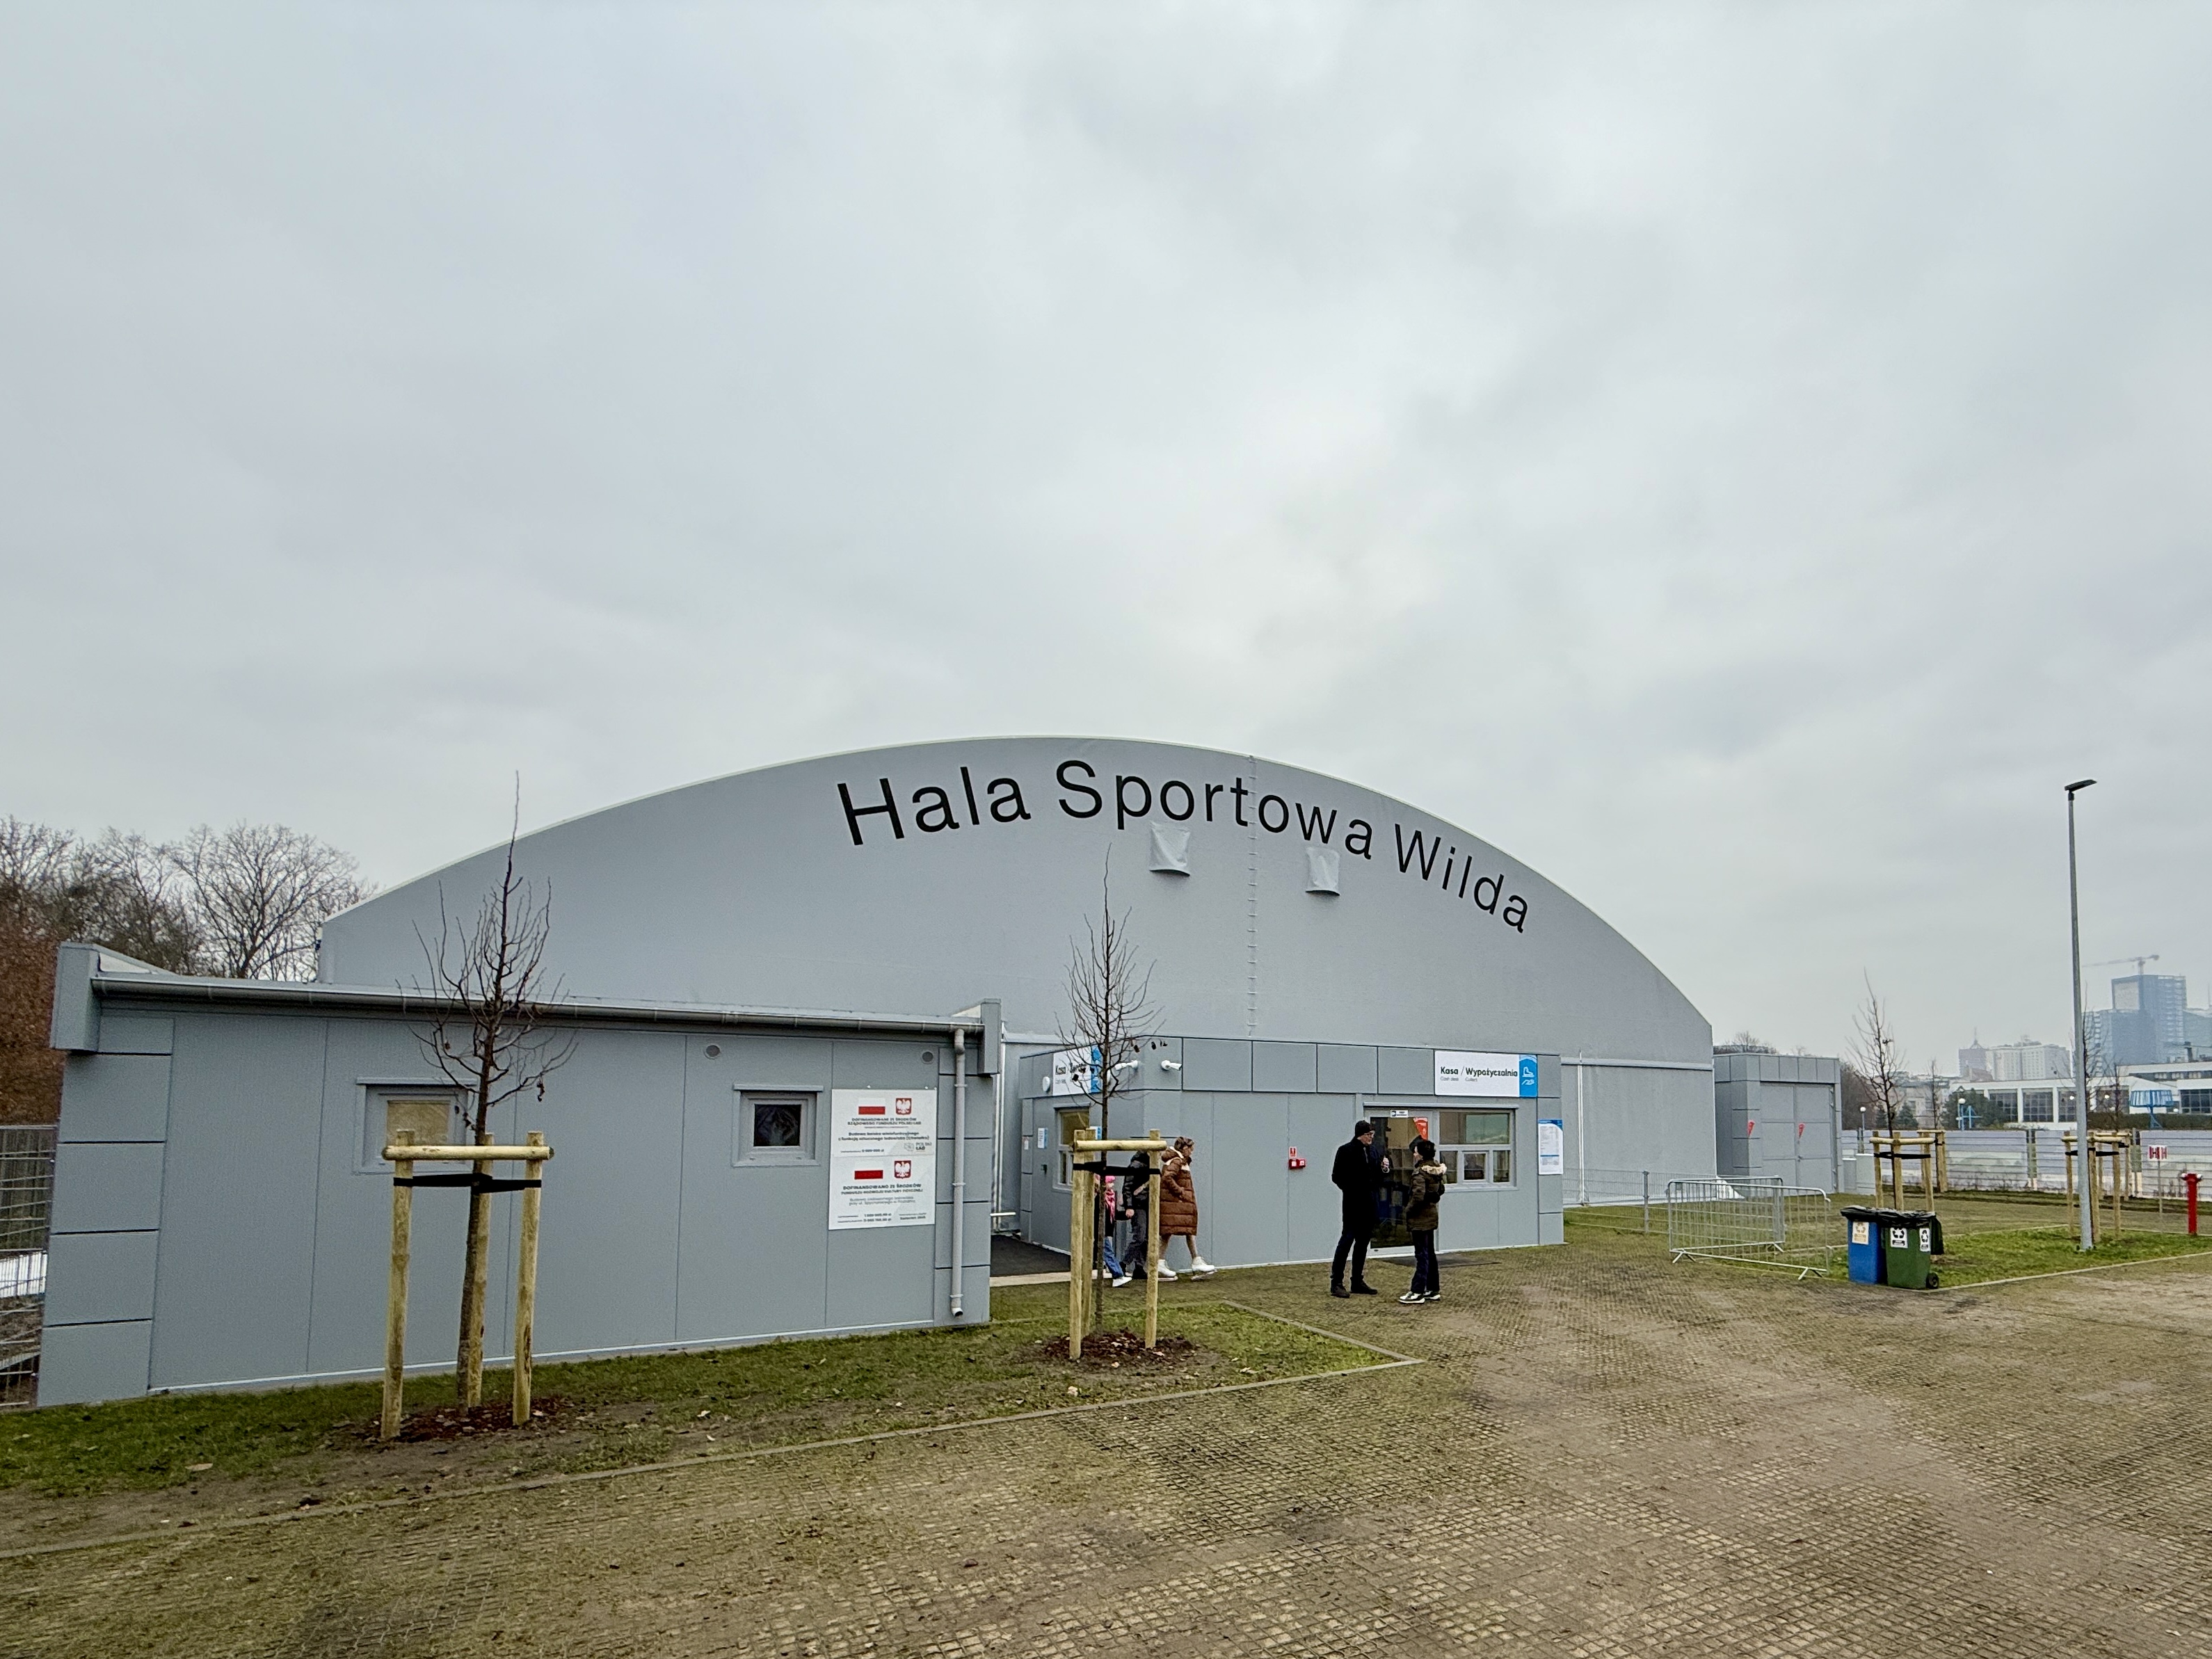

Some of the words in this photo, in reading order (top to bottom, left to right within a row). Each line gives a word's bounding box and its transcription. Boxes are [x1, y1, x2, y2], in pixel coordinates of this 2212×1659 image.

[837, 766, 1031, 846] Hala
[1057, 760, 1372, 860] Sportowa
[1395, 823, 1528, 933] Wilda
[1441, 1066, 1459, 1075] Kasa
[1465, 1067, 1518, 1077] Wypożyczalnia
